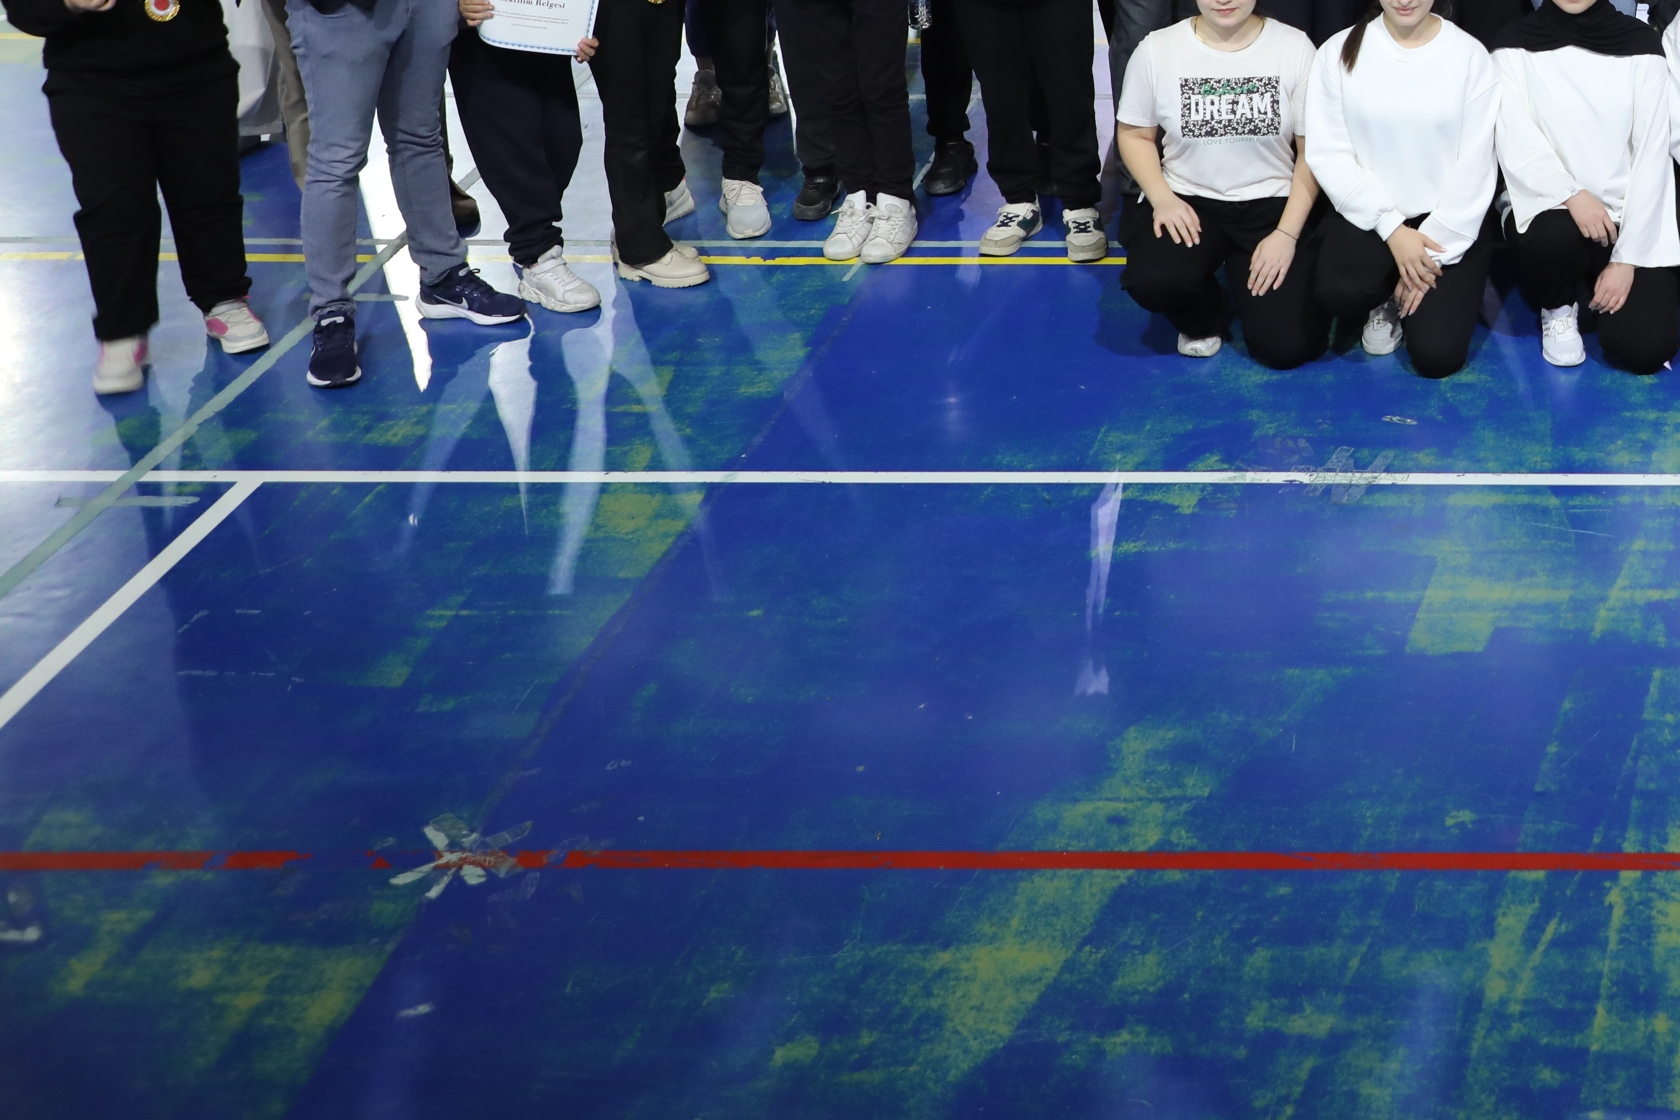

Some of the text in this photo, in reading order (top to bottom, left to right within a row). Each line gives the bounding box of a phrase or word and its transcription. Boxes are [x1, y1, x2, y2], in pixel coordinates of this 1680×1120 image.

[535, 0, 565, 9] Belgesi
[1190, 92, 1273, 120] DREAM
[1203, 136, 1260, 146] LOVE YOURSELF
